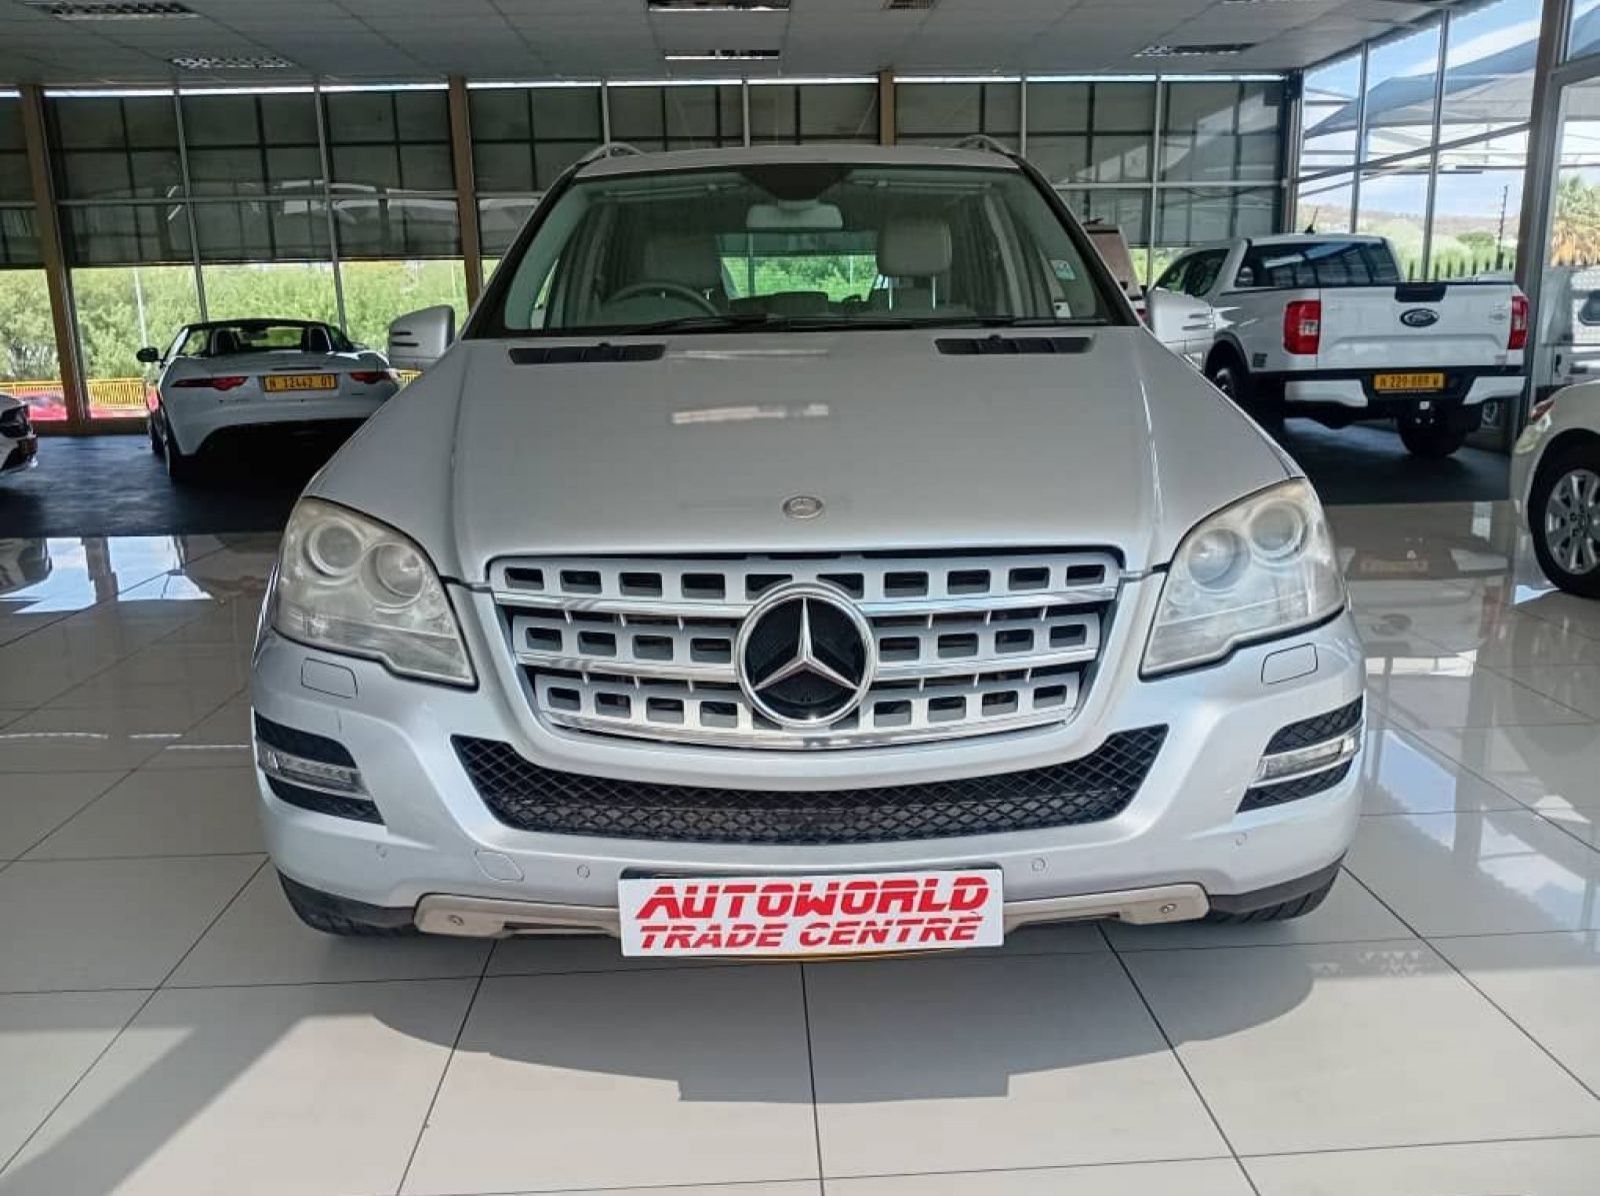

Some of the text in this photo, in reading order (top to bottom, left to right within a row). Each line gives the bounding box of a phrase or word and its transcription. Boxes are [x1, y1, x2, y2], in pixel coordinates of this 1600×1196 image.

[636, 877, 990, 919] AUTOWORLD
[640, 916, 984, 950] TRADE CENTRE
